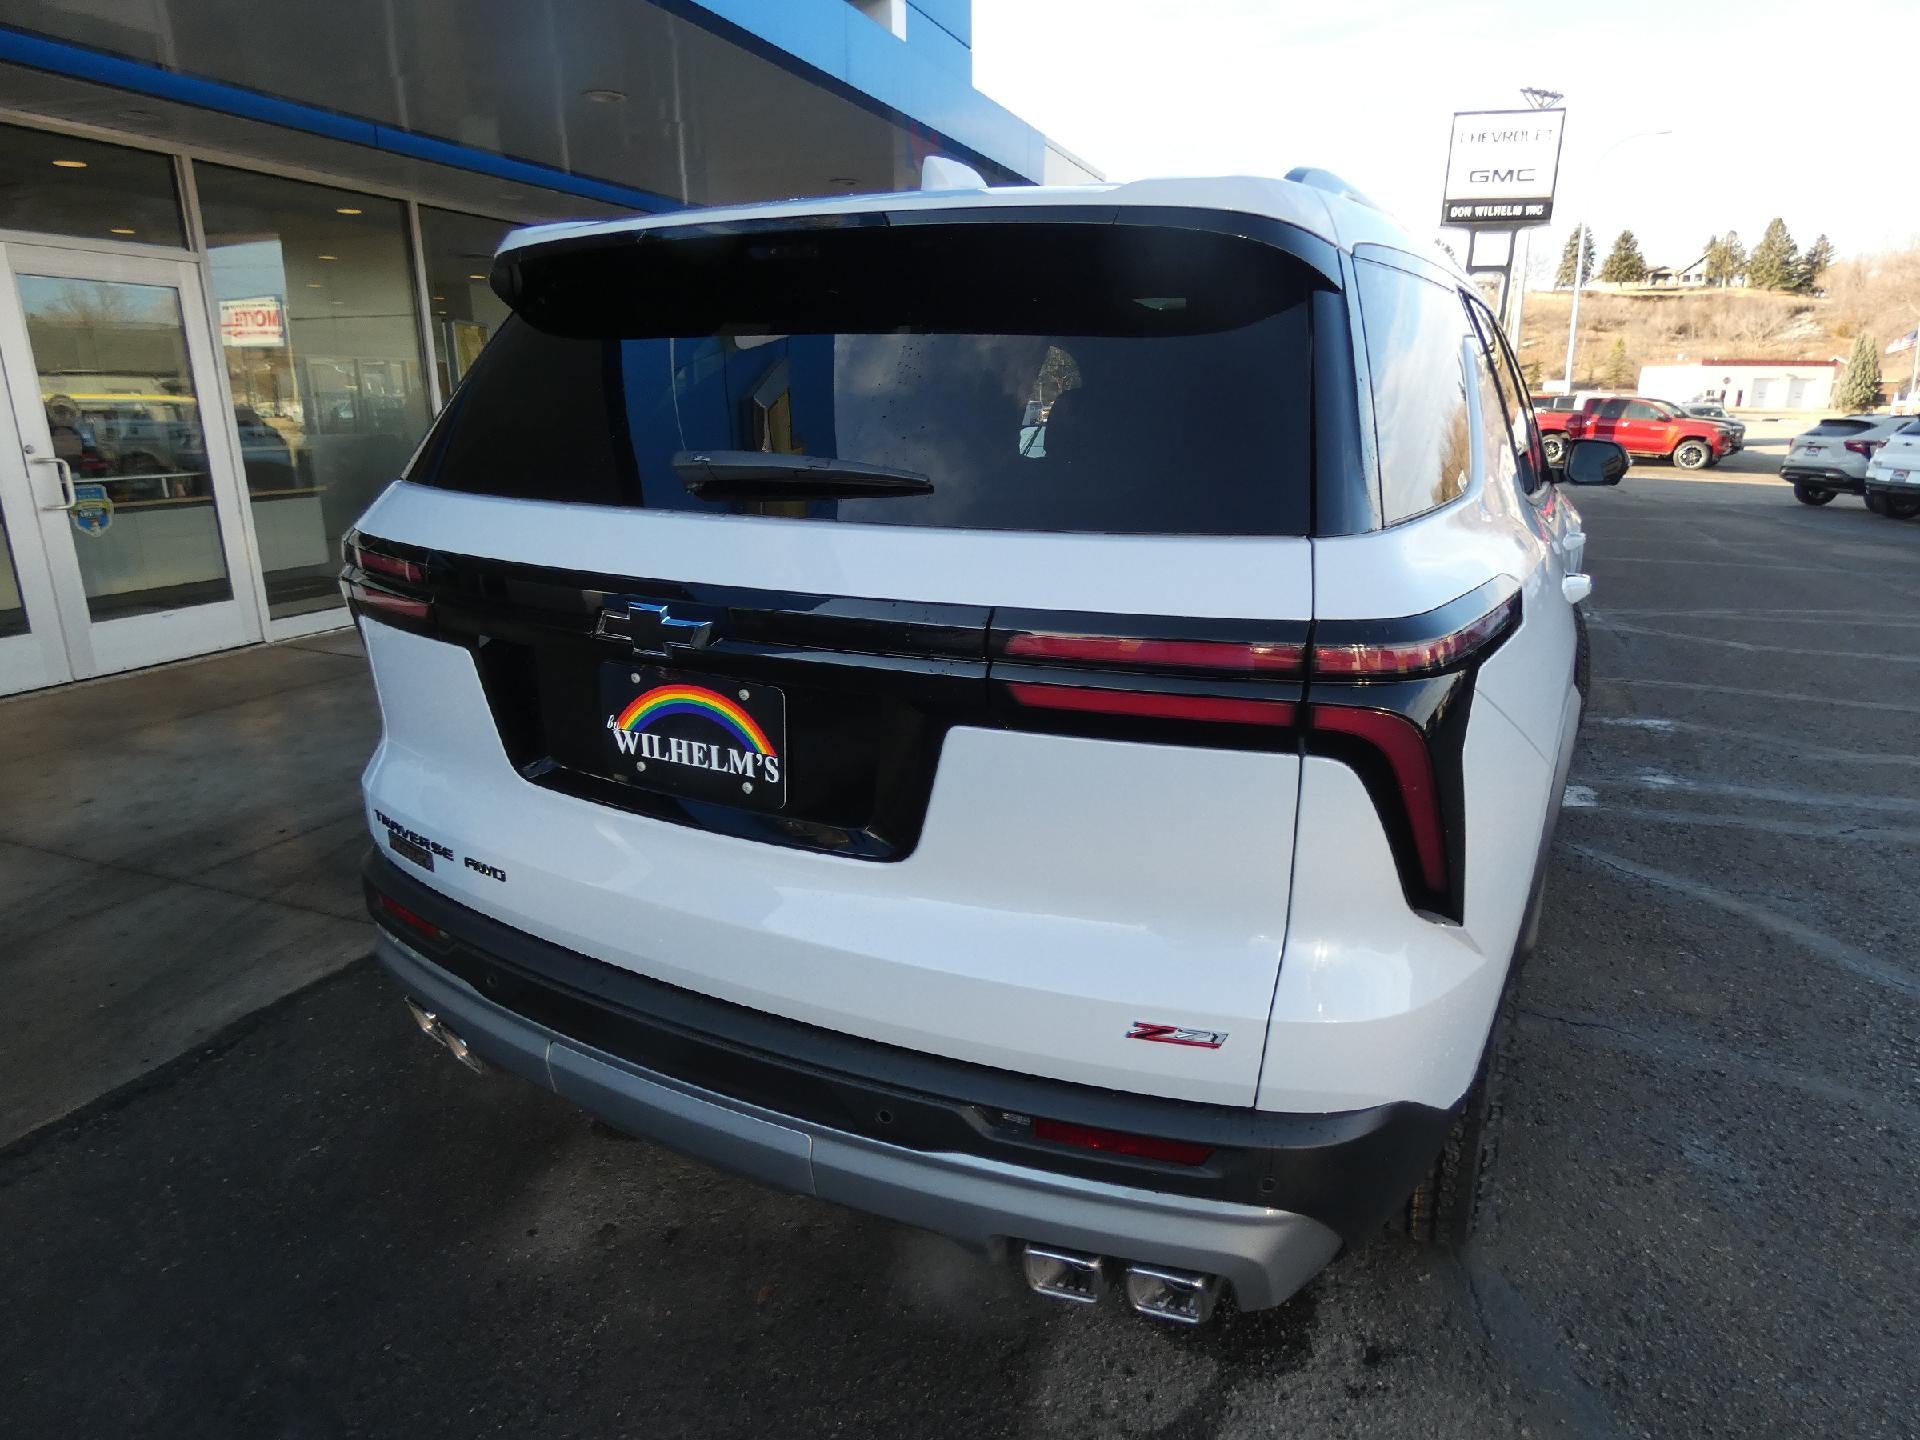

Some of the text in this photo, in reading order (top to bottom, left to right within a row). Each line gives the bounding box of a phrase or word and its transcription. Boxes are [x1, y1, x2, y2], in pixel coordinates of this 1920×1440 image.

[1459, 129, 1553, 143] CHEVROLET
[1469, 168, 1536, 183] GMC
[1450, 206, 1471, 218] DON
[1474, 205, 1523, 217] WILHELM
[606, 714, 621, 733] by
[612, 729, 780, 784] WILHELM'S
[374, 809, 455, 862] TRAVERSE
[464, 856, 507, 882] AWD
[1125, 1021, 1230, 1050] Z71
